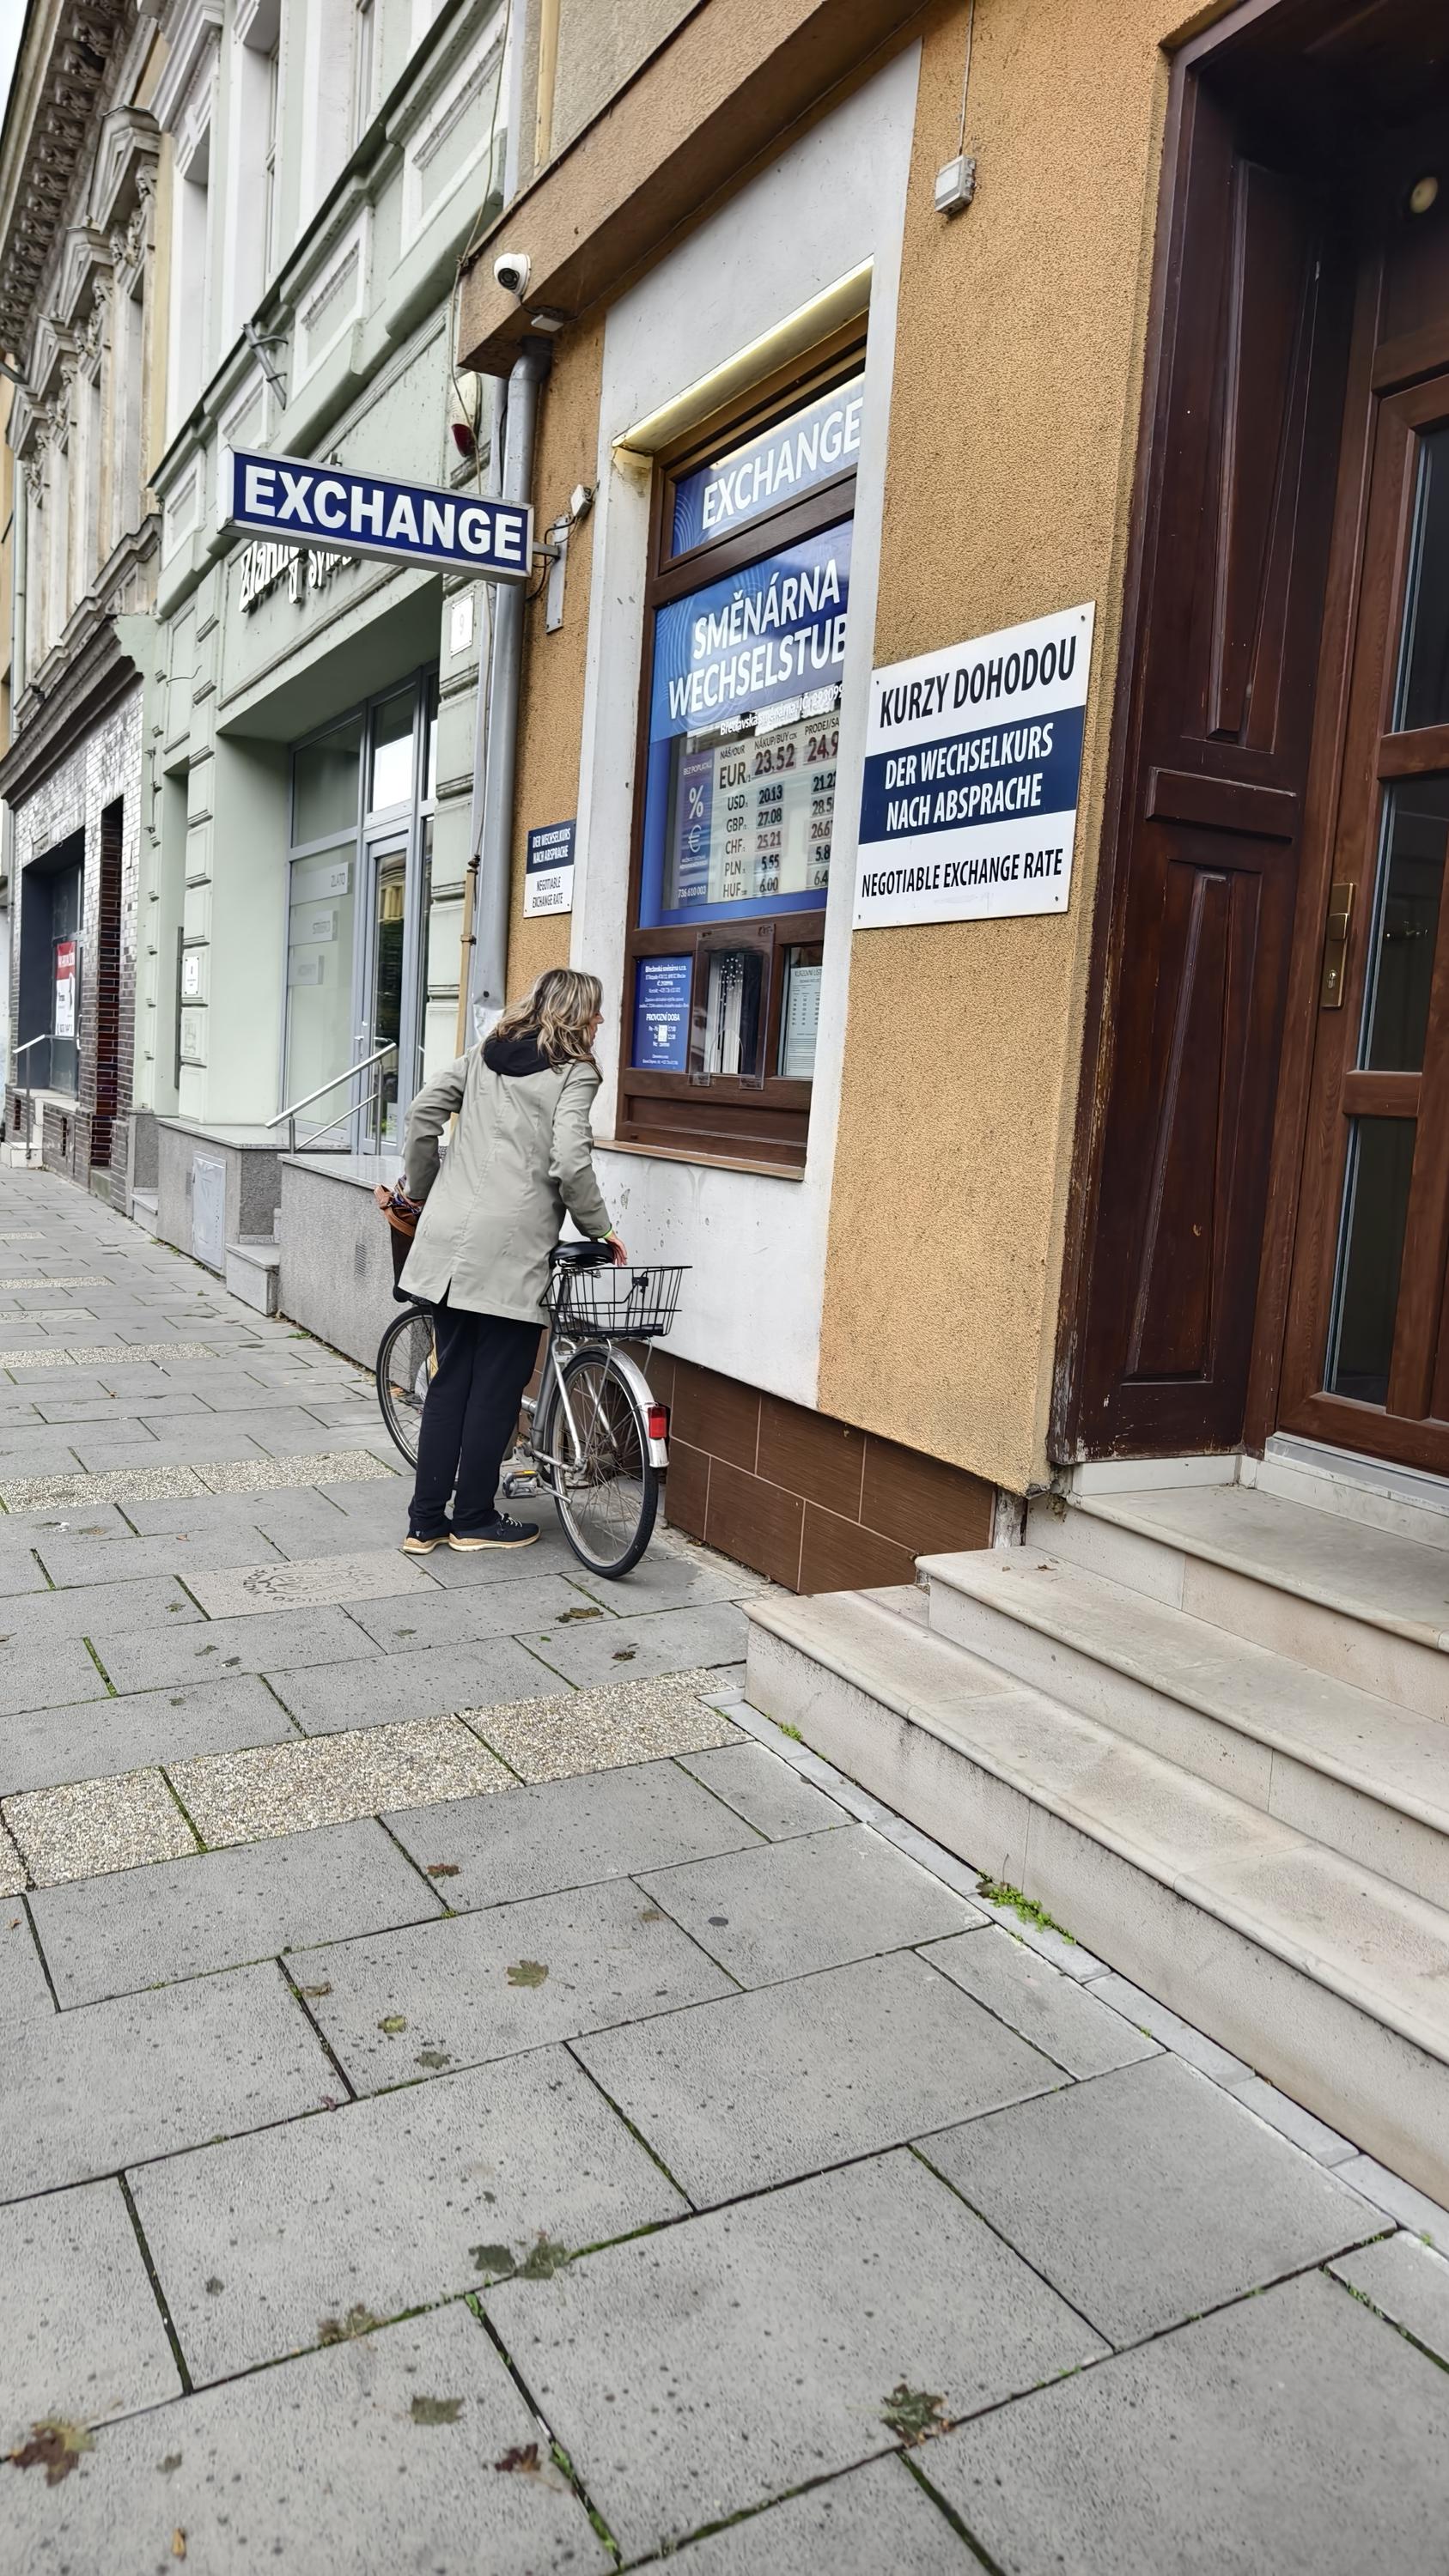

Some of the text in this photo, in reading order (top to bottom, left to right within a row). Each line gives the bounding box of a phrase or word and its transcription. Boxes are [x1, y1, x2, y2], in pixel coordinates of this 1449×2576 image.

[703, 397, 863, 530] EXCHANGE
[245, 465, 522, 561] EXCHANGE
[693, 559, 840, 659] SMĚNÁRNA
[669, 613, 847, 720] WECHSELSTUB
[880, 635, 1076, 728] KURZY DOHODOU
[720, 762, 746, 789] EUR
[755, 743, 795, 775] 23.52
[885, 722, 1053, 789] DER WECHSELKURS
[727, 817, 744, 833] GBP
[758, 808, 782, 827] 27.08
[728, 794, 745, 811] USD
[886, 773, 1043, 831] NACH ABSPRACHE
[533, 835, 542, 848] DER
[725, 838, 742, 854] CHF
[536, 876, 561, 891] NEGOTIABLE
[722, 882, 741, 897] HUF
[724, 860, 741, 876] PLN
[861, 848, 1063, 898] NEGOTIABLE EXCHANGE RATE
[533, 892, 563, 908] EXCHANGE RATE
